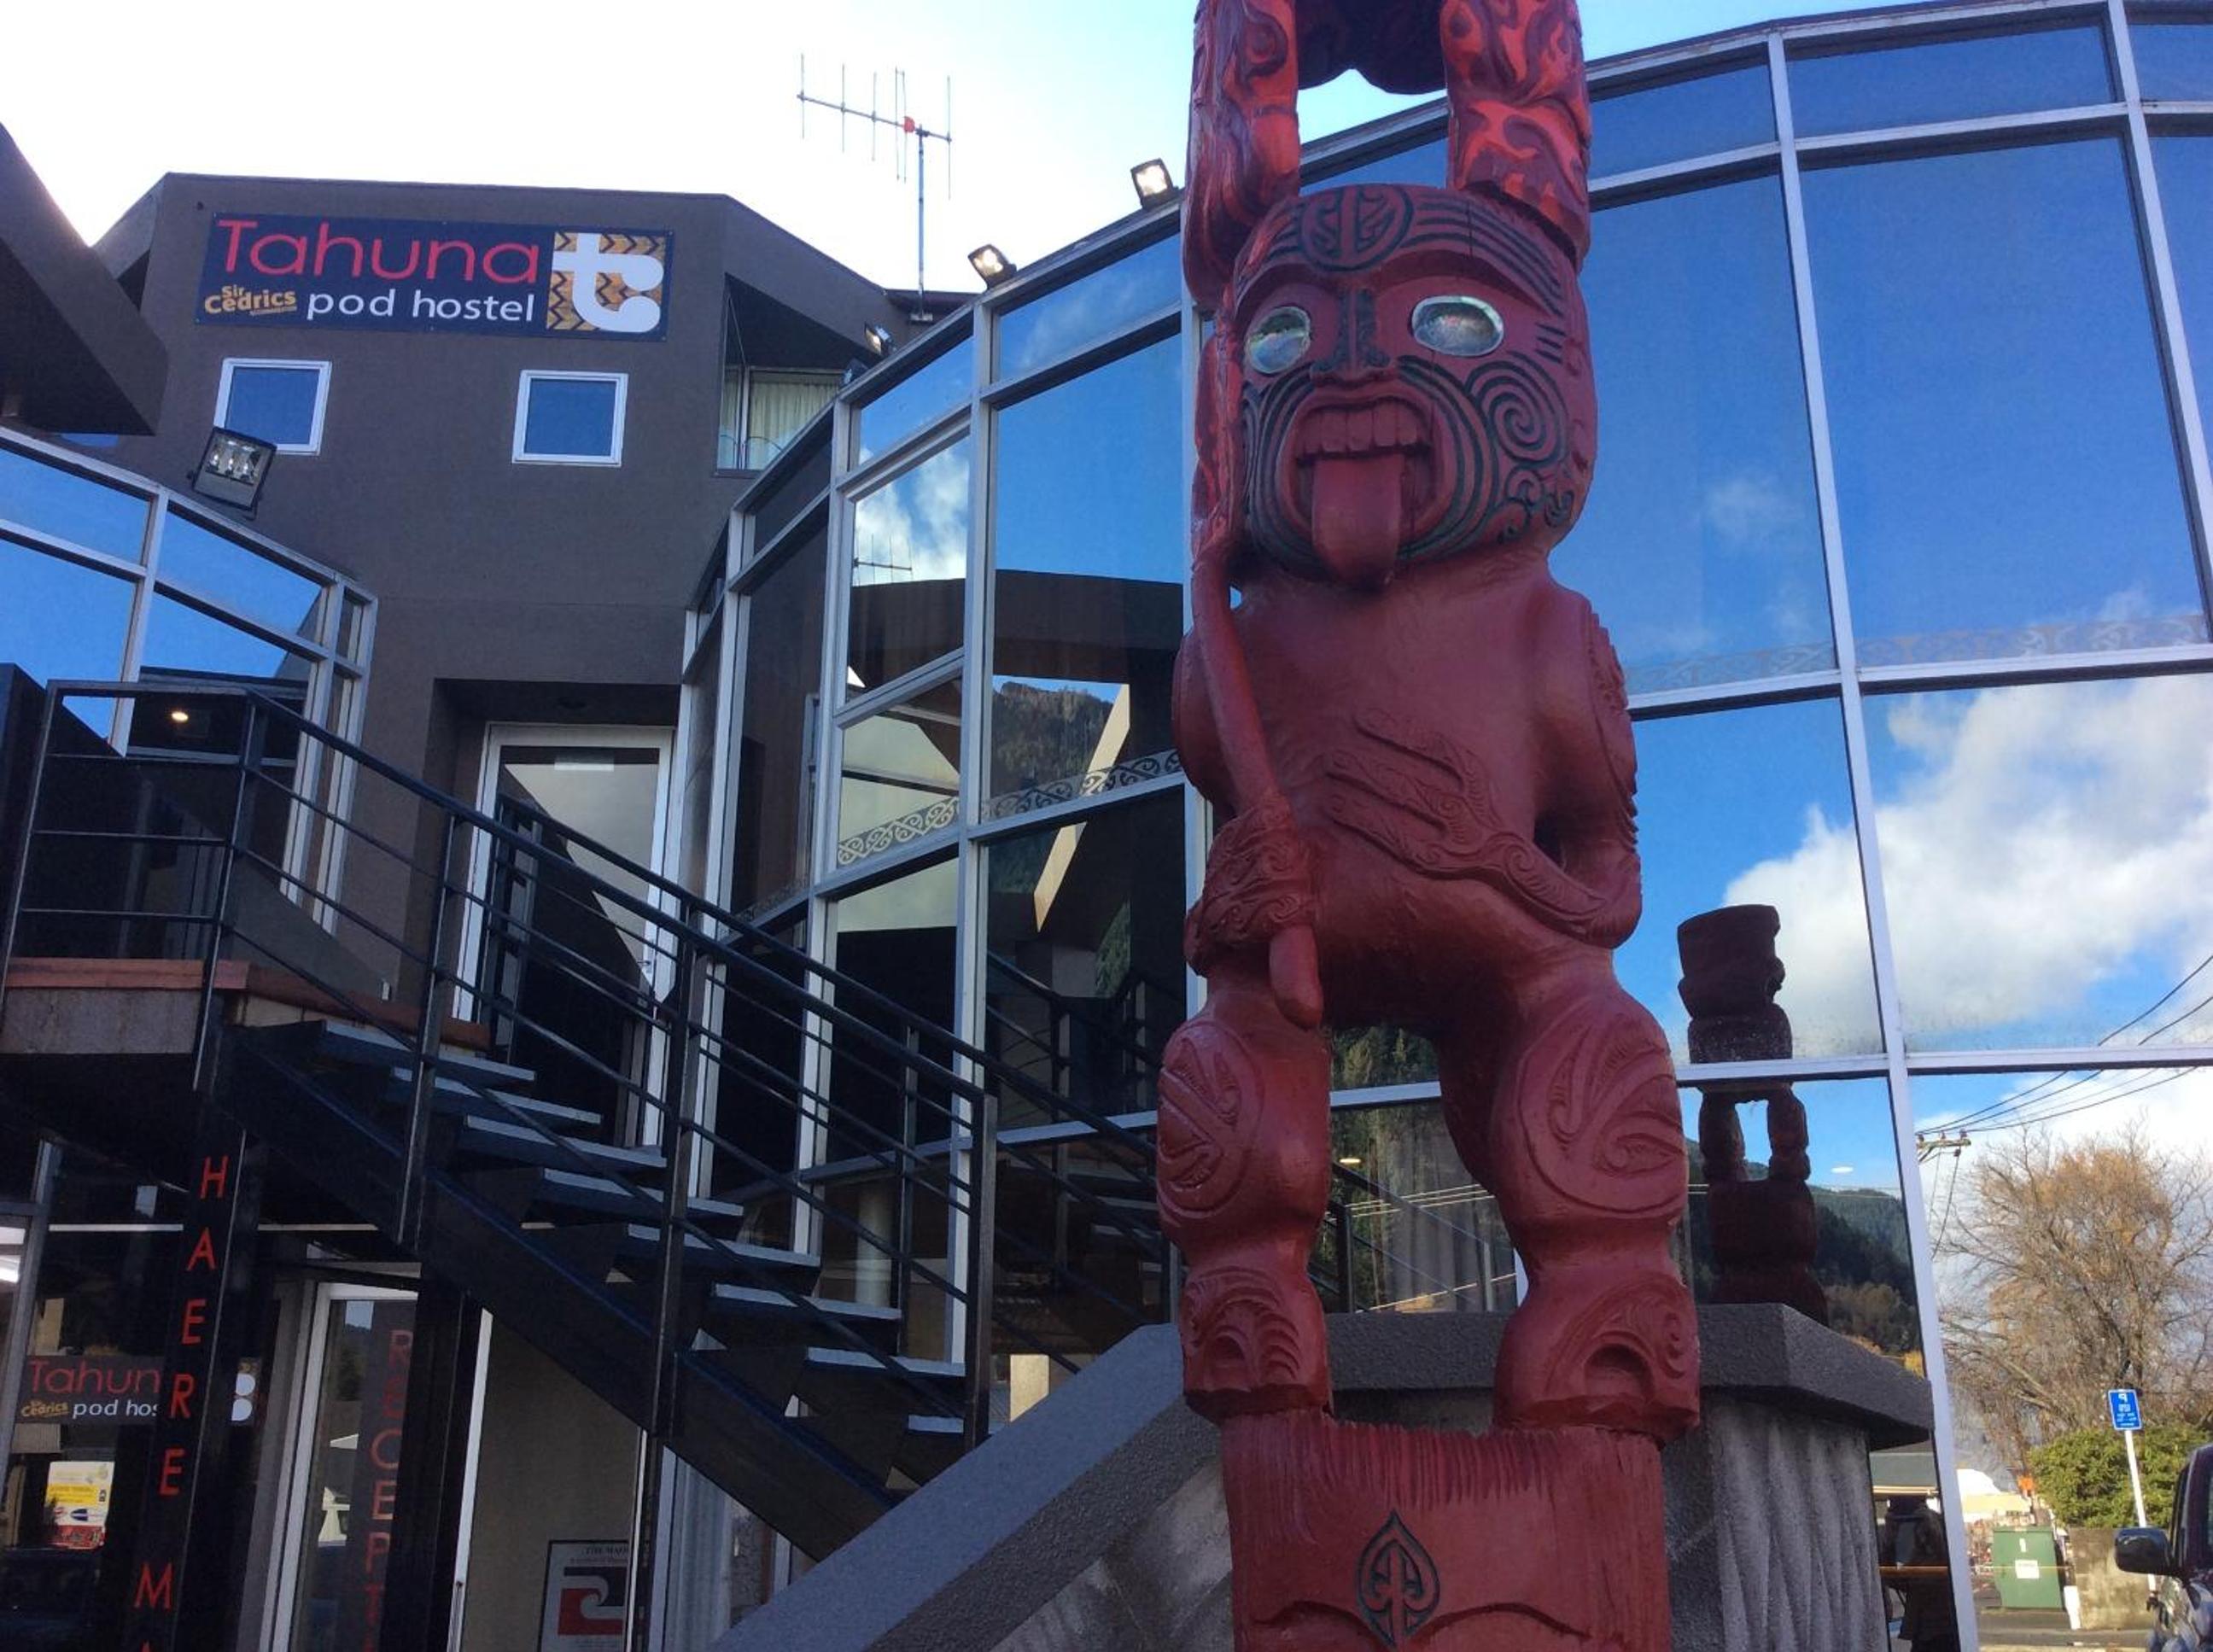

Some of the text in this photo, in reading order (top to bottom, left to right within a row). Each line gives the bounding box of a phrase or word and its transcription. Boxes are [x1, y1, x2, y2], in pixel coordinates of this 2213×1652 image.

[217, 219, 540, 283] Tahuna
[205, 289, 296, 315] Cedrics
[222, 284, 245, 298] Sir
[307, 288, 535, 322] pod hostel
[28, 1360, 161, 1394] Tahun
[72, 1399, 118, 1419] pod
